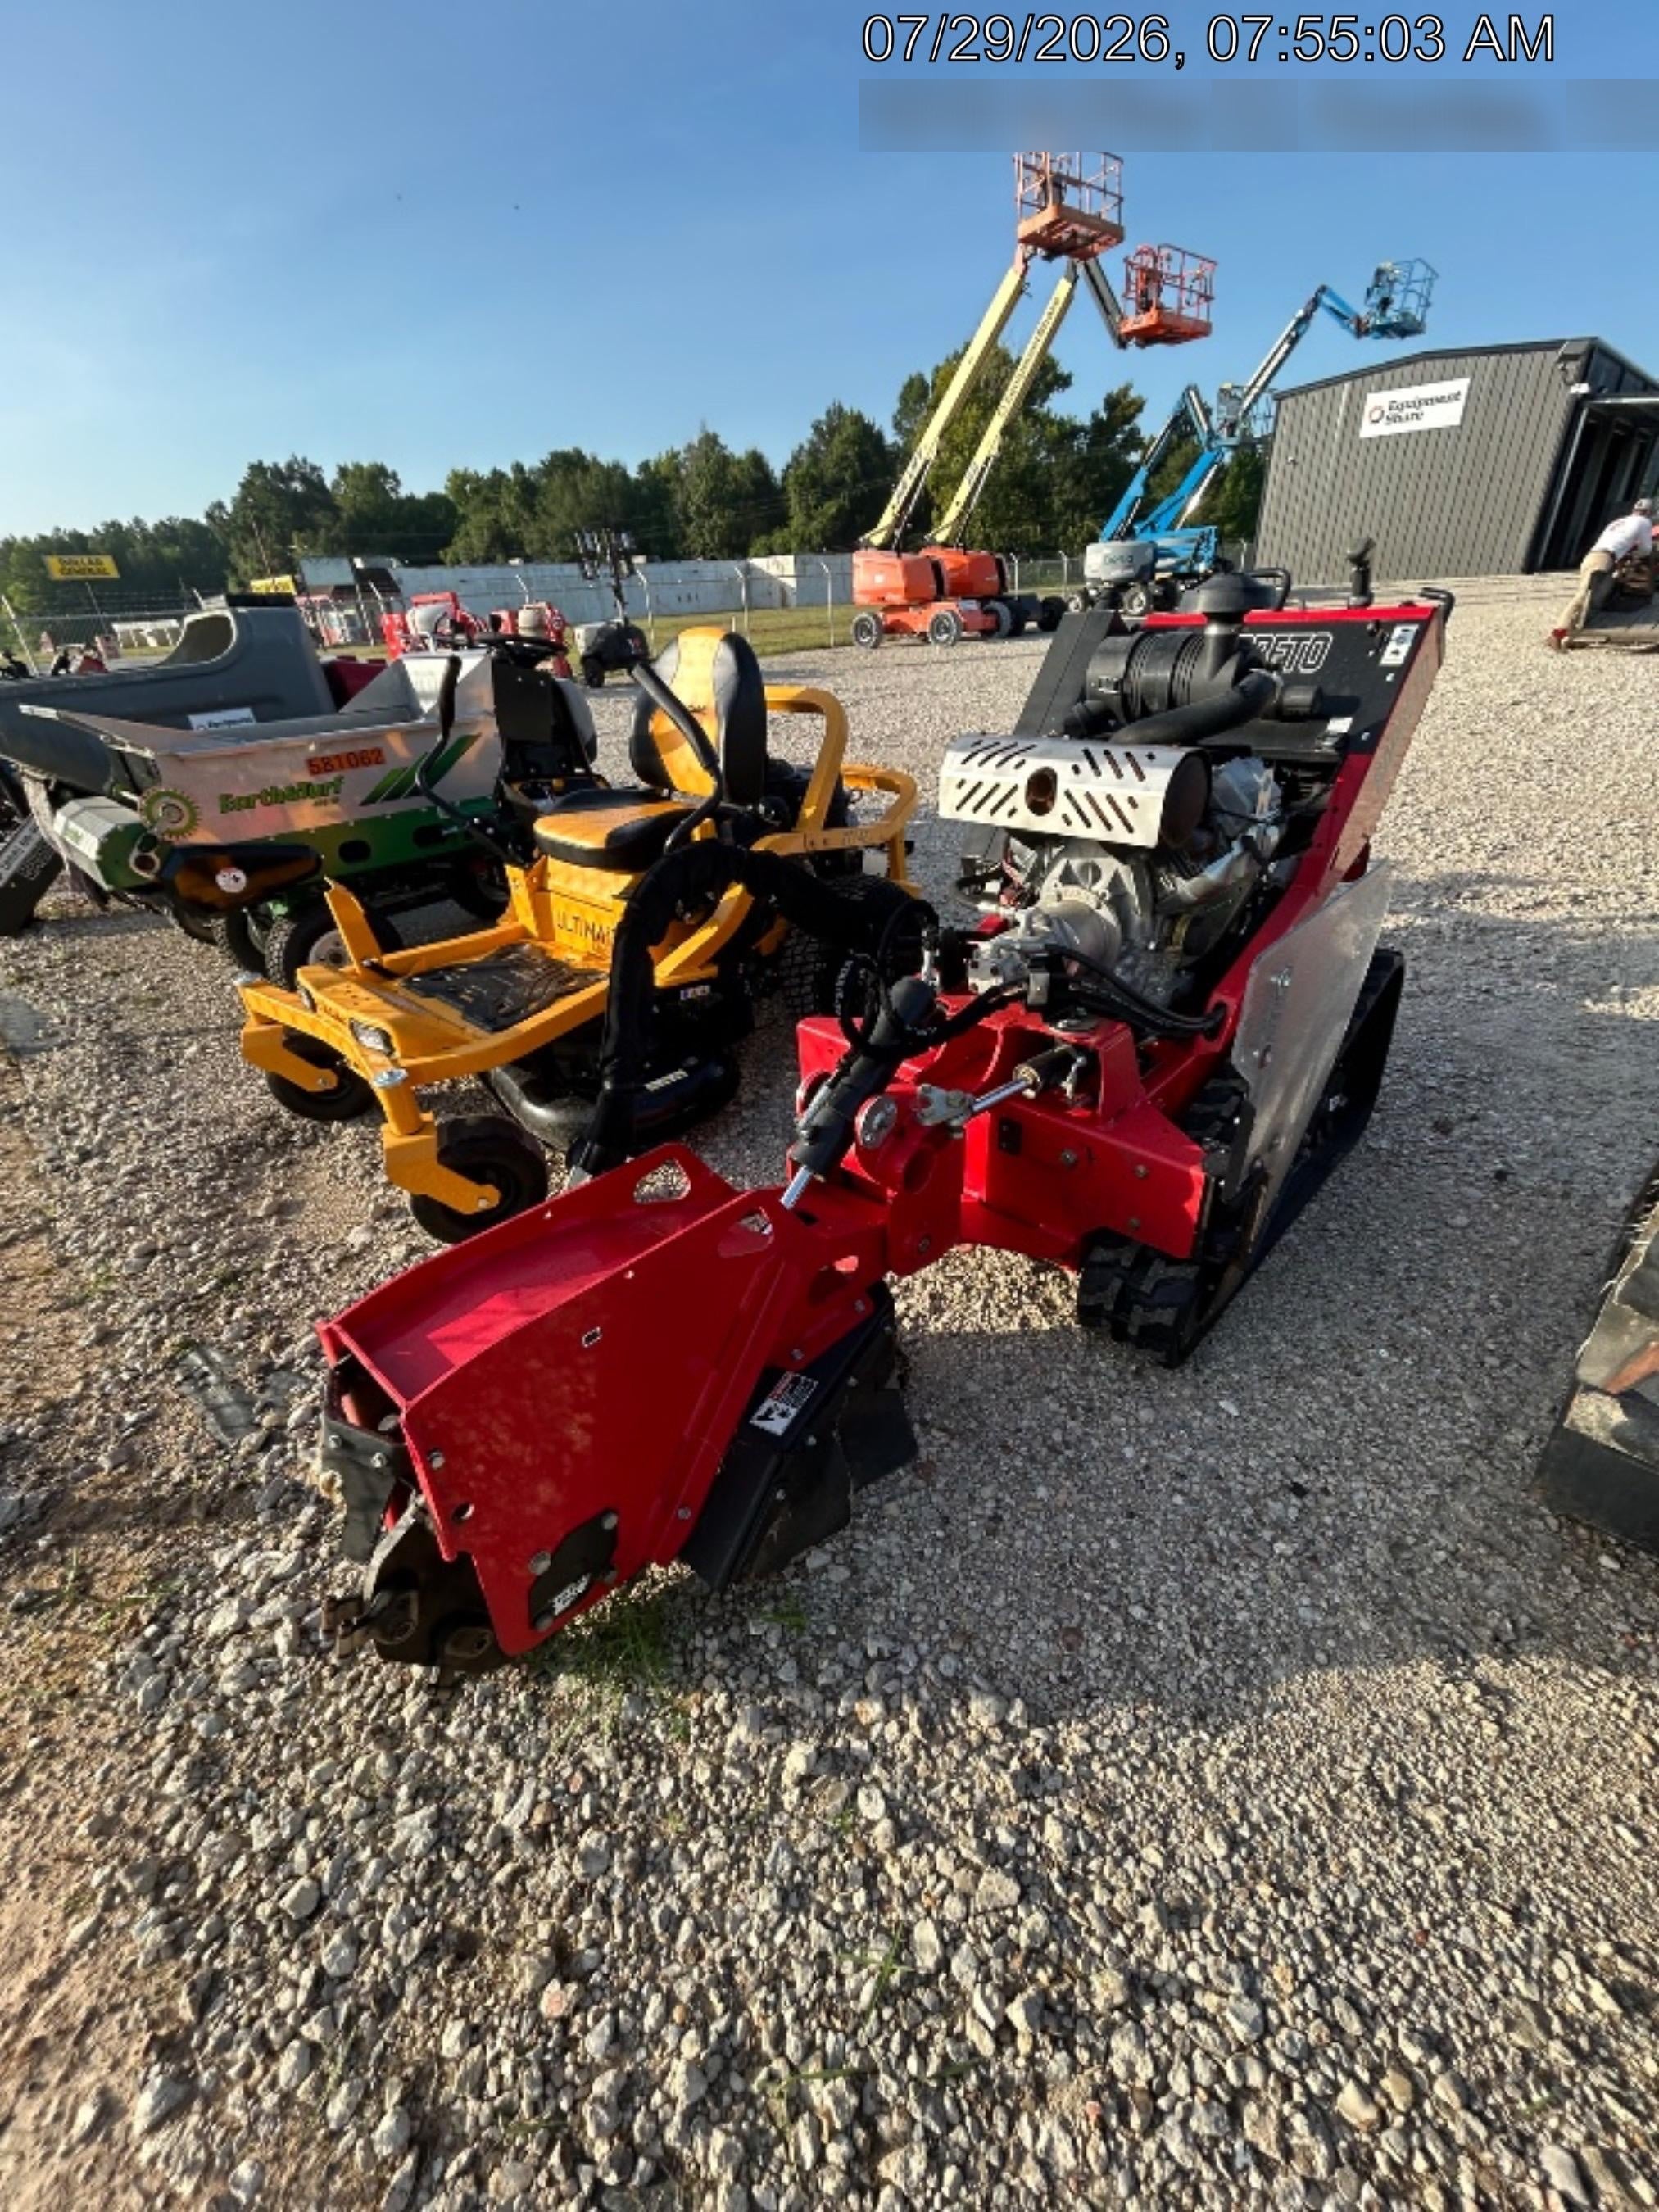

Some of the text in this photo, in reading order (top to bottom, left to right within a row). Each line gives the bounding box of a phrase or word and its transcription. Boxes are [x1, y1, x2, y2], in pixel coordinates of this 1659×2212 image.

[1389, 390, 1462, 413] Equipment
[1385, 411, 1425, 425] Share
[1238, 631, 1334, 674] RETO
